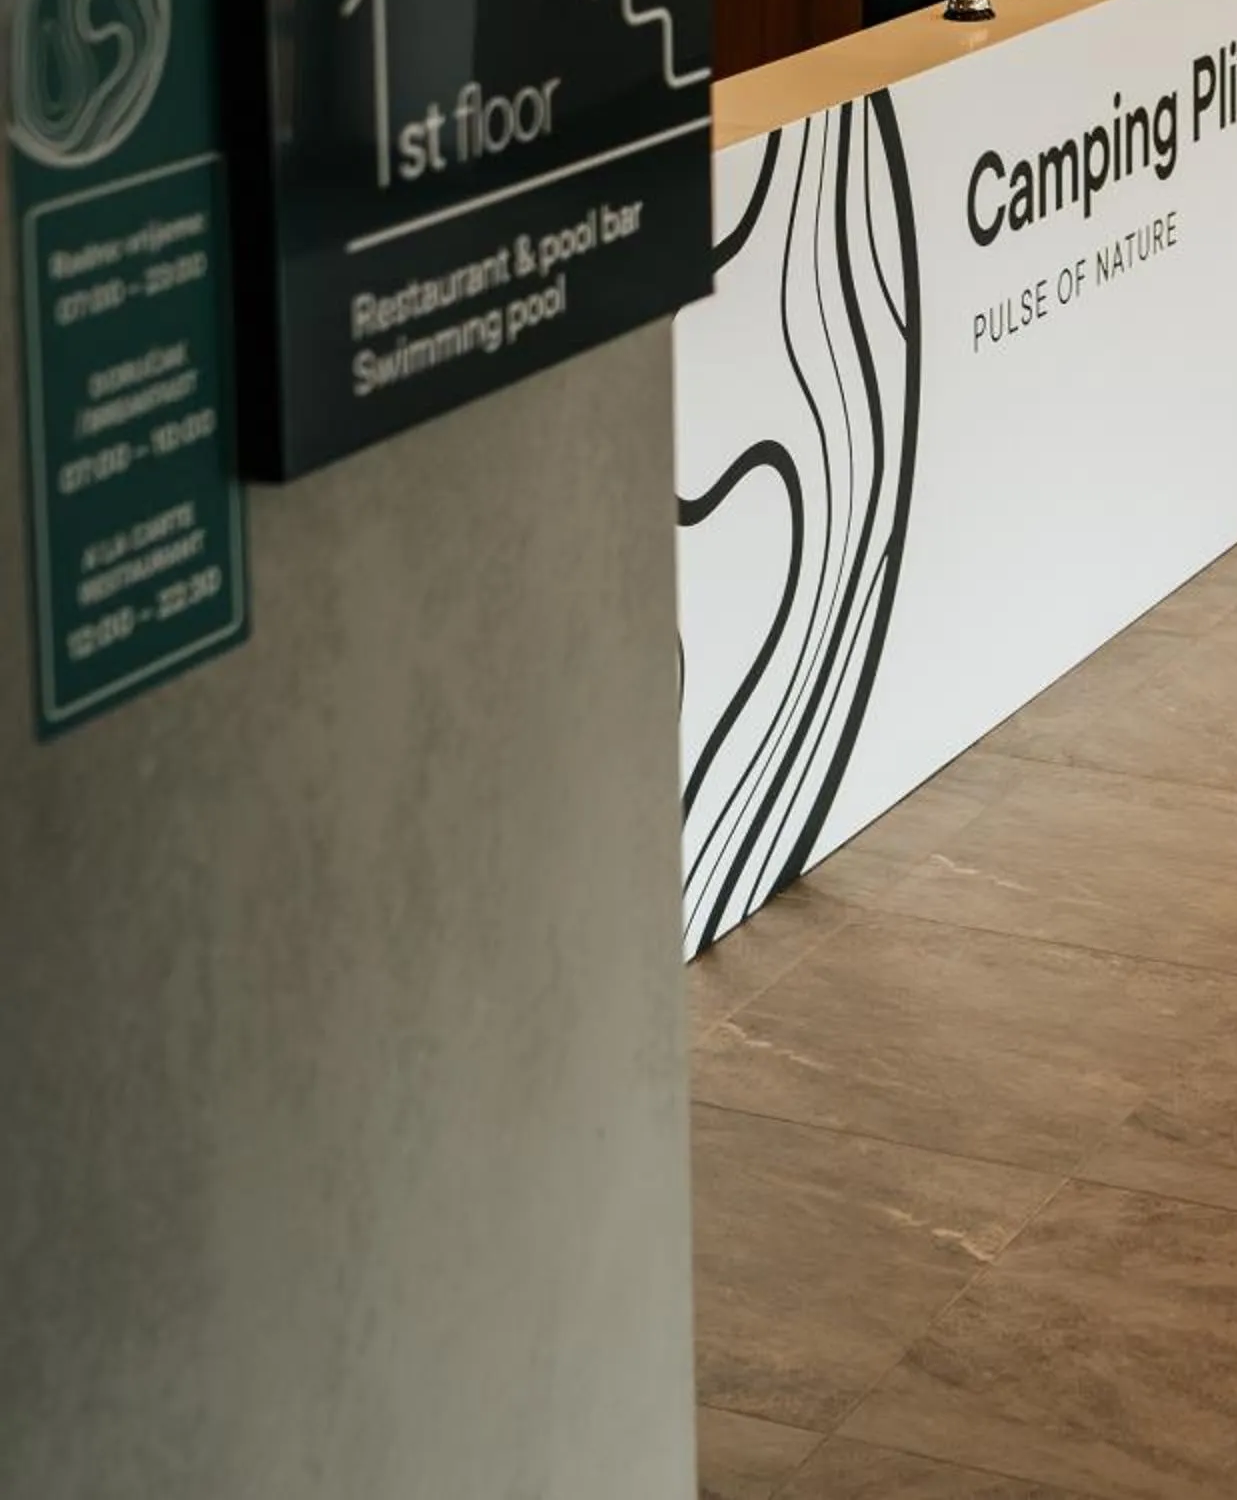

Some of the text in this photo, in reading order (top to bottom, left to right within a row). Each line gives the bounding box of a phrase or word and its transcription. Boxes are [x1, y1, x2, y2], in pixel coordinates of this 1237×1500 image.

[453, 78, 561, 164] floor
[967, 90, 1178, 247] Camping
[352, 200, 643, 342] Restaurant & pool bar
[353, 273, 566, 397] Swimming pool
[973, 211, 1179, 354] PULSE OF NATURE
